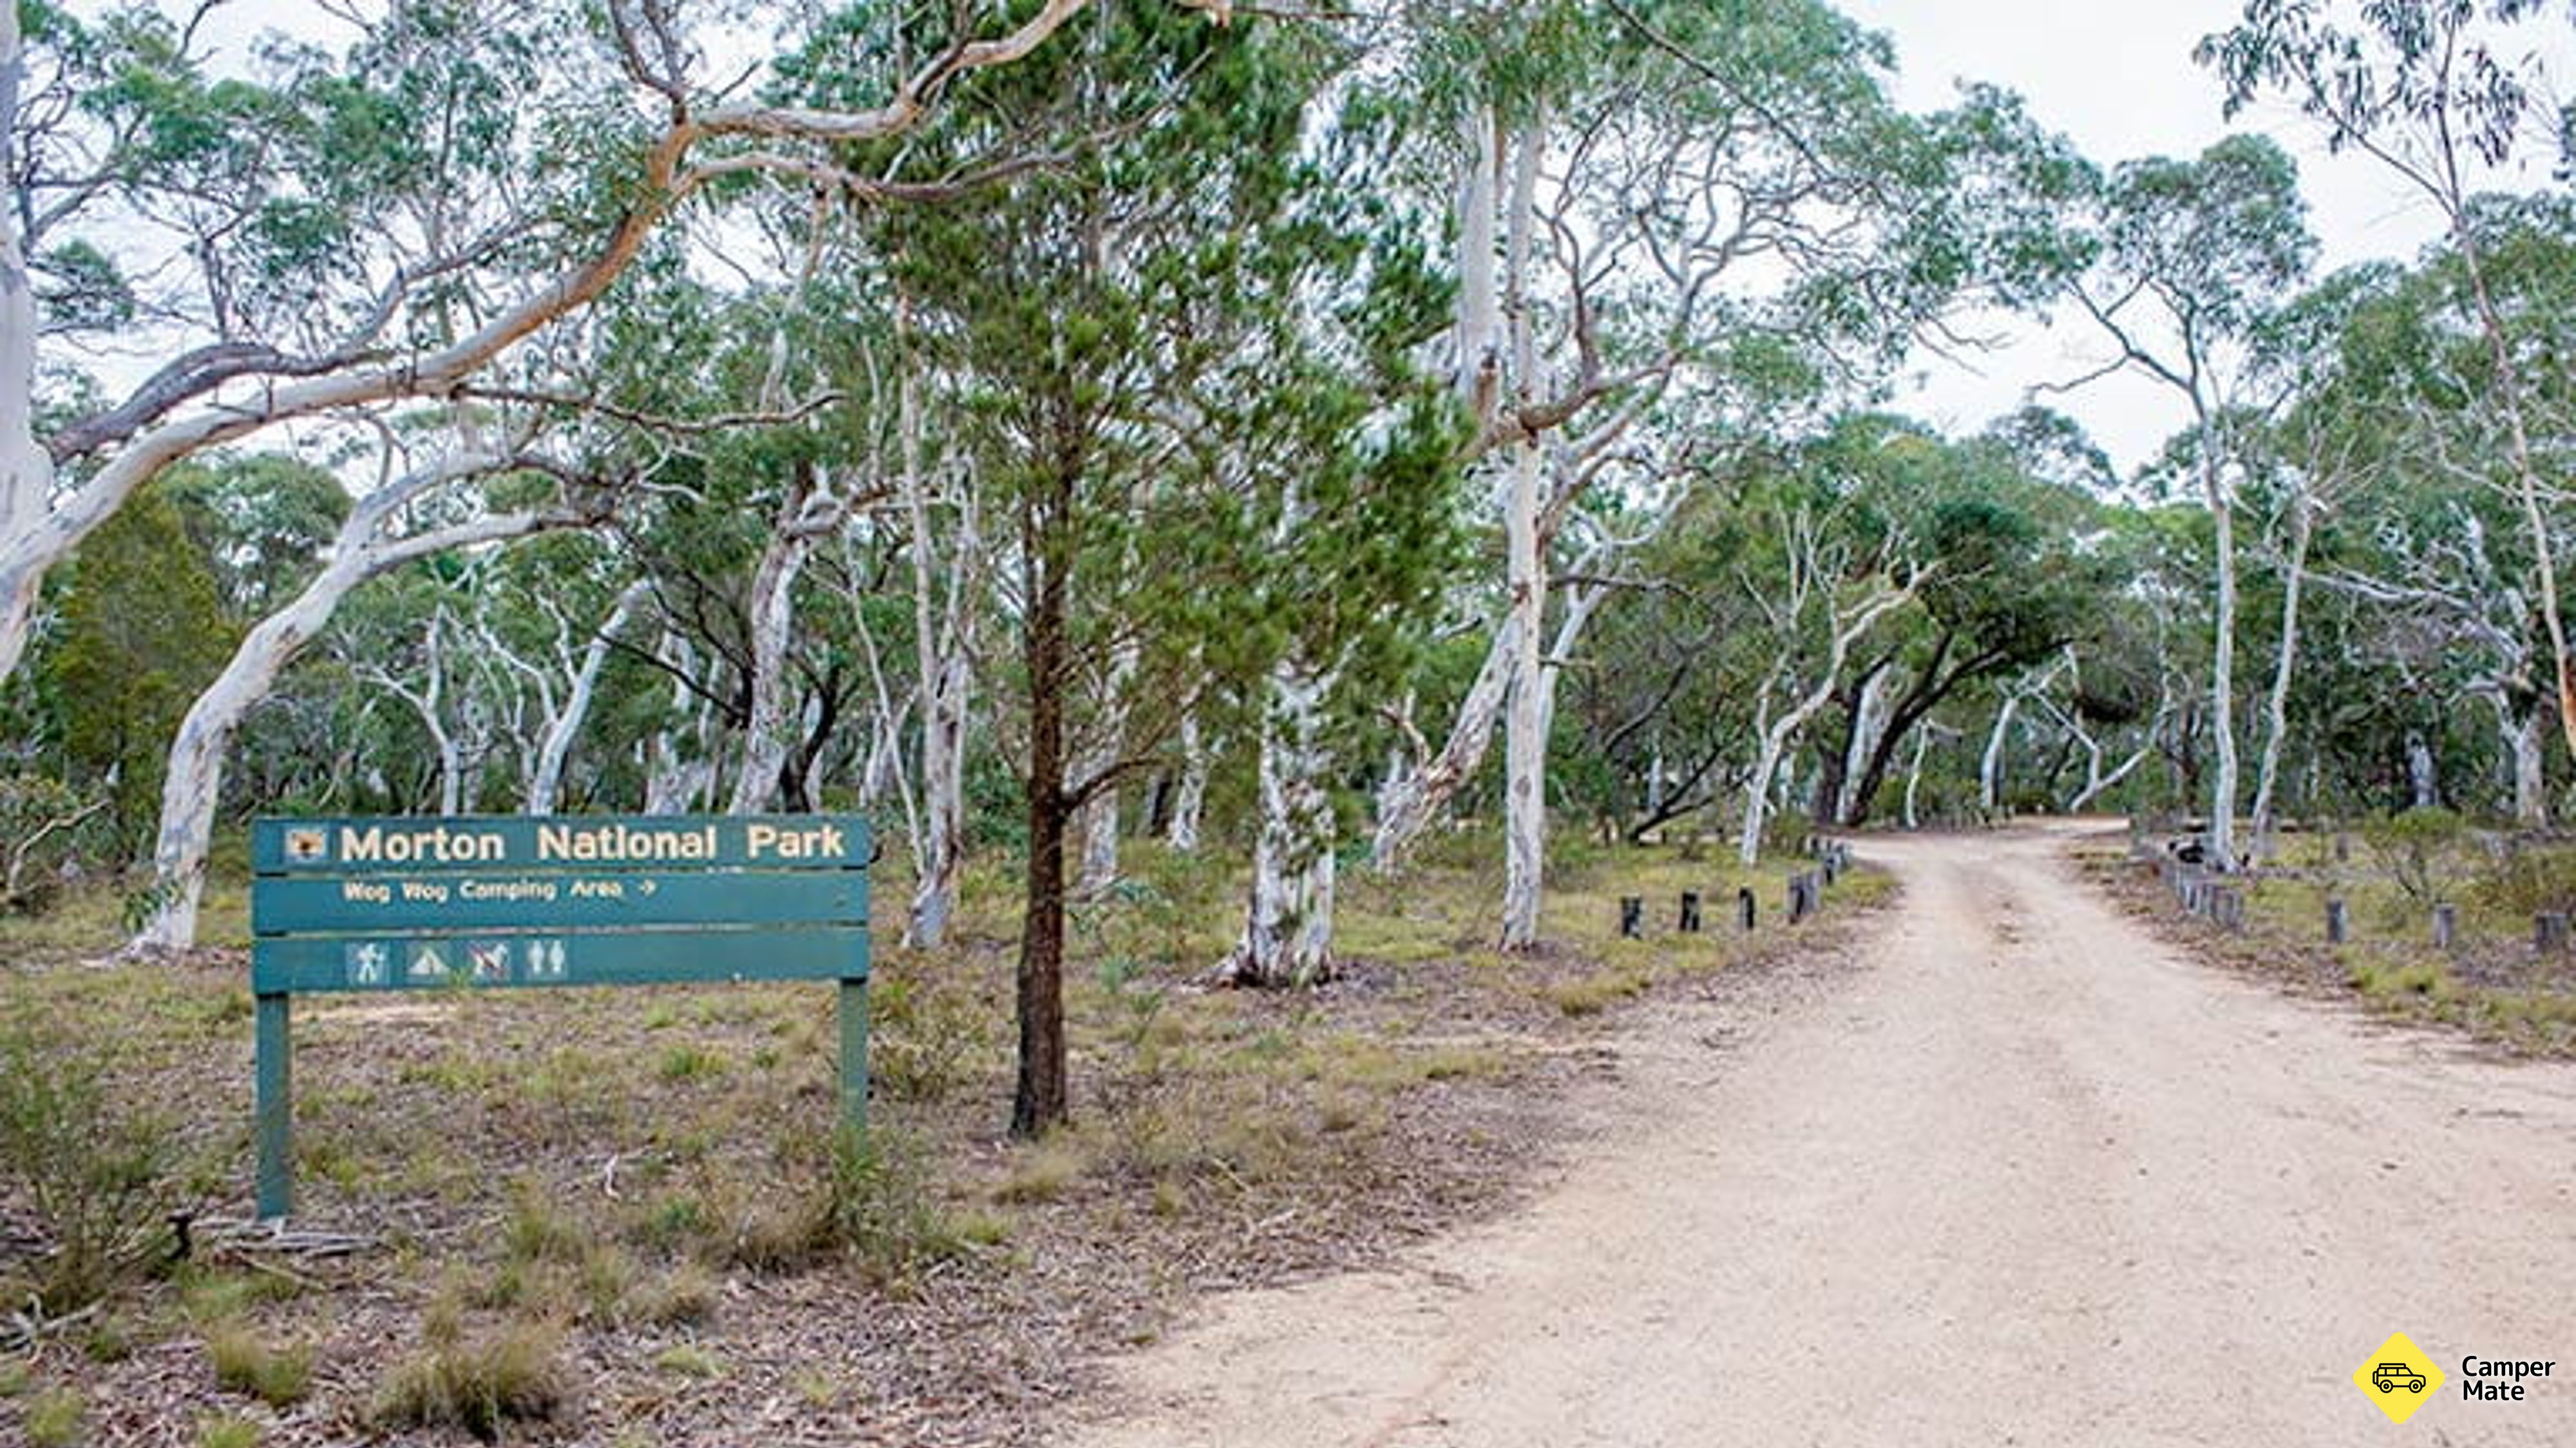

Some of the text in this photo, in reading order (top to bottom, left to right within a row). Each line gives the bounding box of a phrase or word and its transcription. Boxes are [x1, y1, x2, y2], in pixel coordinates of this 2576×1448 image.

[341, 823, 845, 862] Morton National Park
[344, 878, 623, 903] Wog Wog Camping Area
